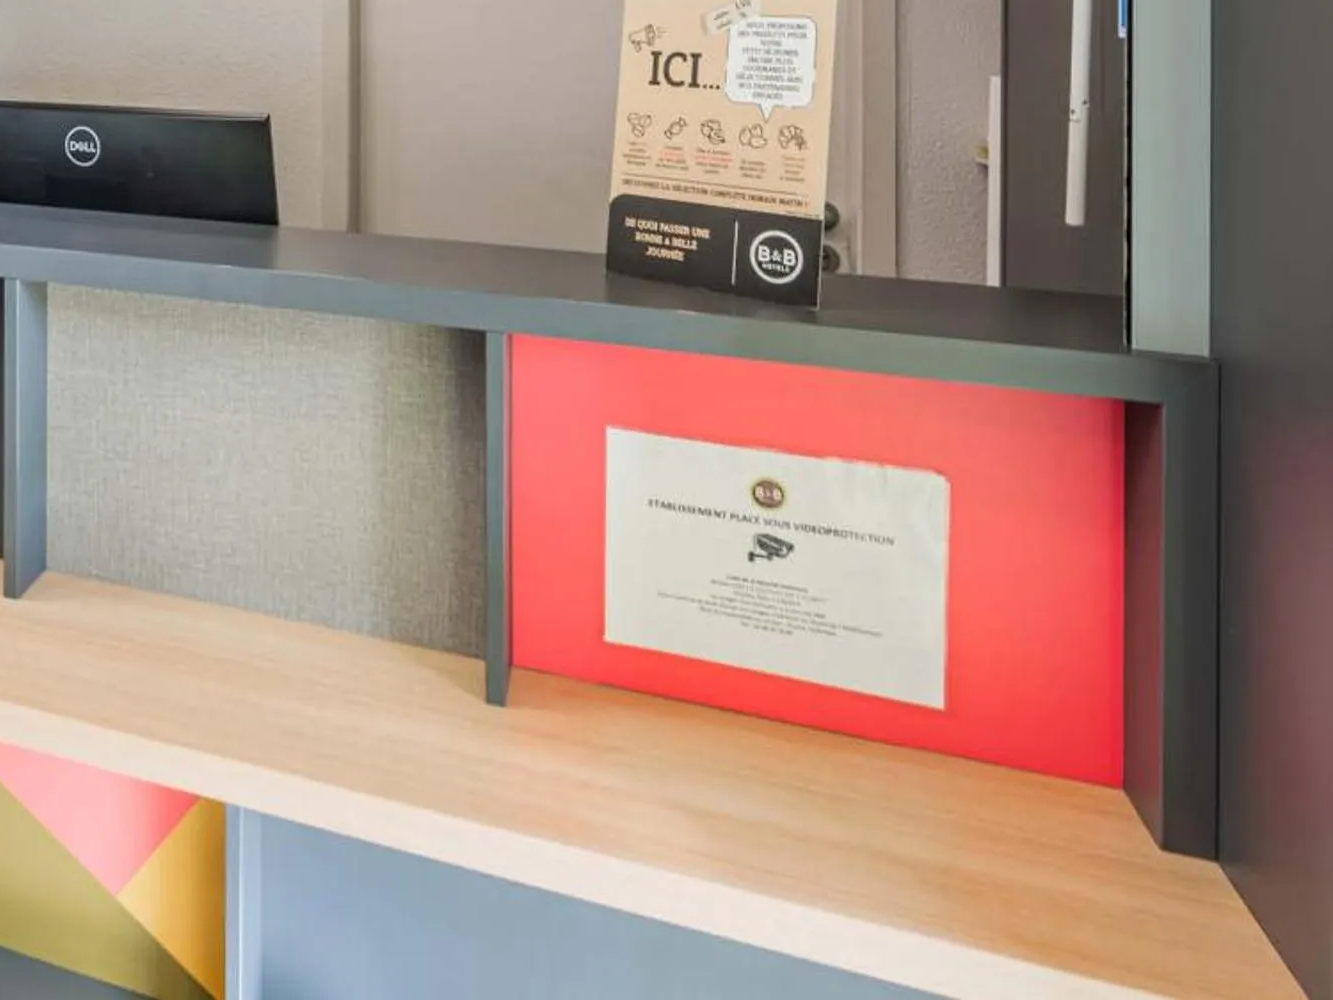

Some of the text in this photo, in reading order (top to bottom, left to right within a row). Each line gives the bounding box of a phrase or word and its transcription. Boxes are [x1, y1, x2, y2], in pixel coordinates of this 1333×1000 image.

[648, 50, 722, 91] ICI...
[70, 140, 97, 153] DELL
[758, 245, 796, 267] B&B
